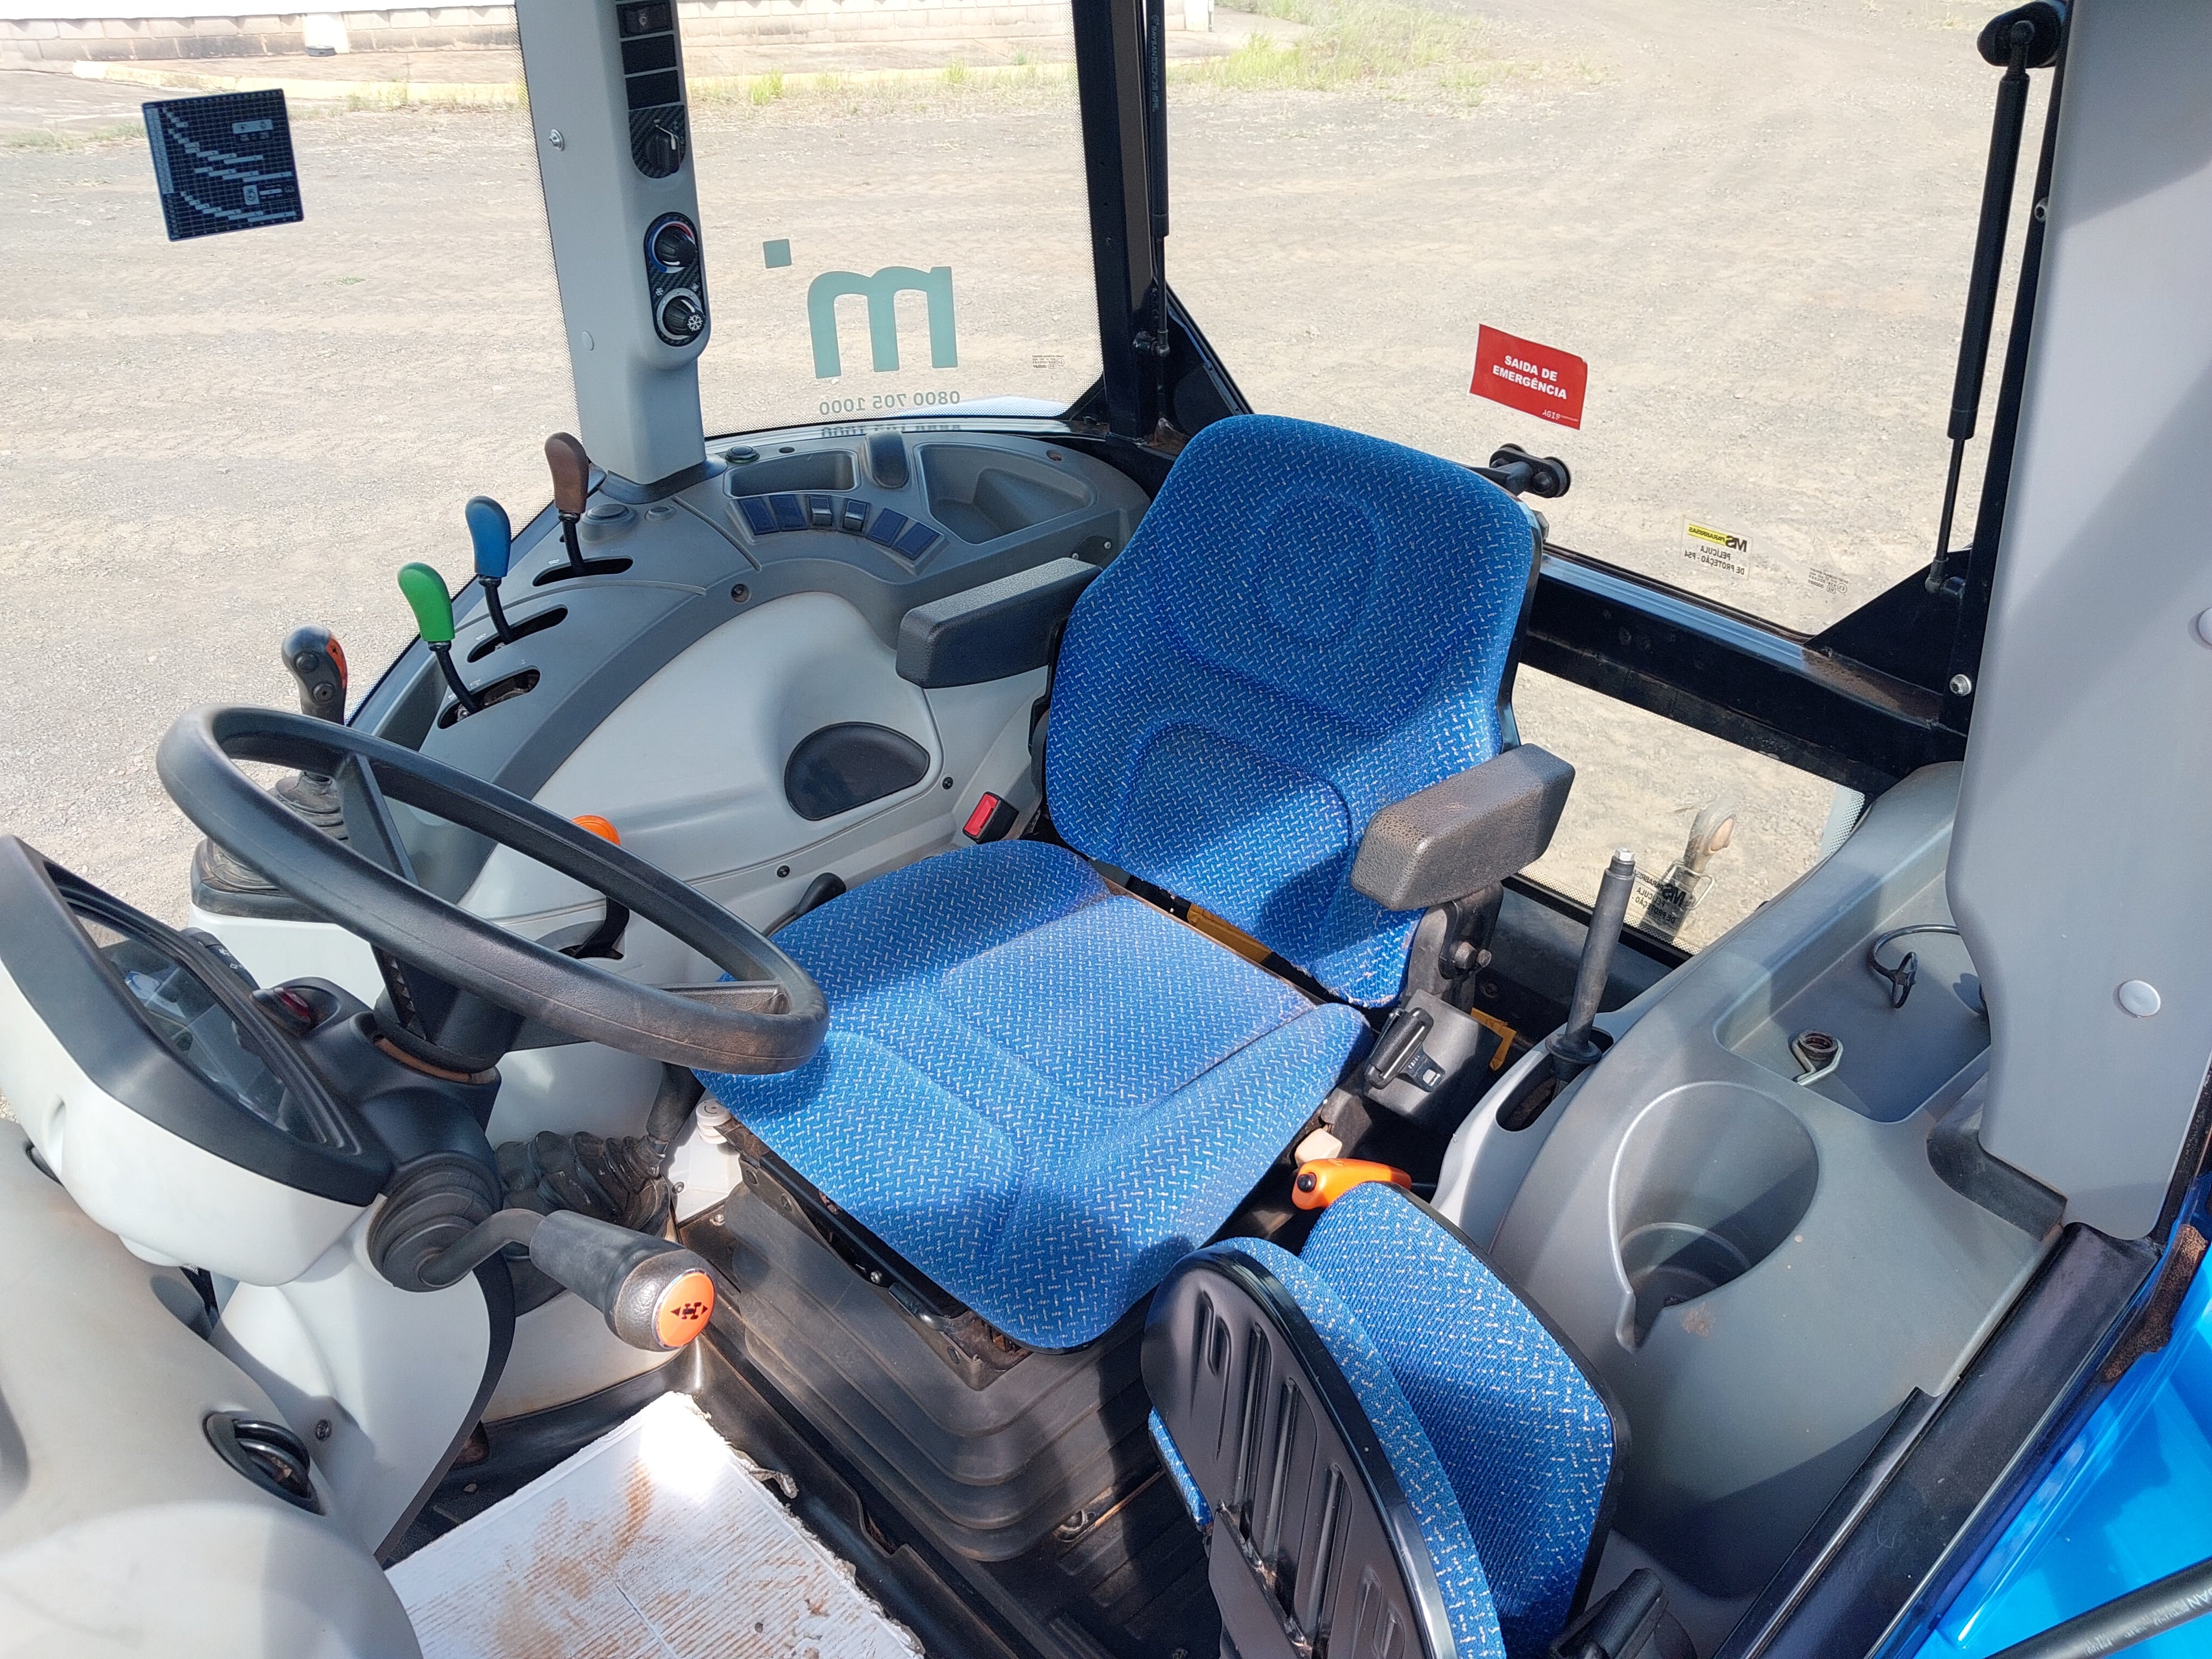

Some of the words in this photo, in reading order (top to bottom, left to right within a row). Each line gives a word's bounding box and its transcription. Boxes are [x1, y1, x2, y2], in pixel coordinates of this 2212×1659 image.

[1492, 364, 1567, 400] EMERGÊNCIA
[1504, 355, 1538, 376] SAIDA
[1541, 368, 1558, 382] DE
